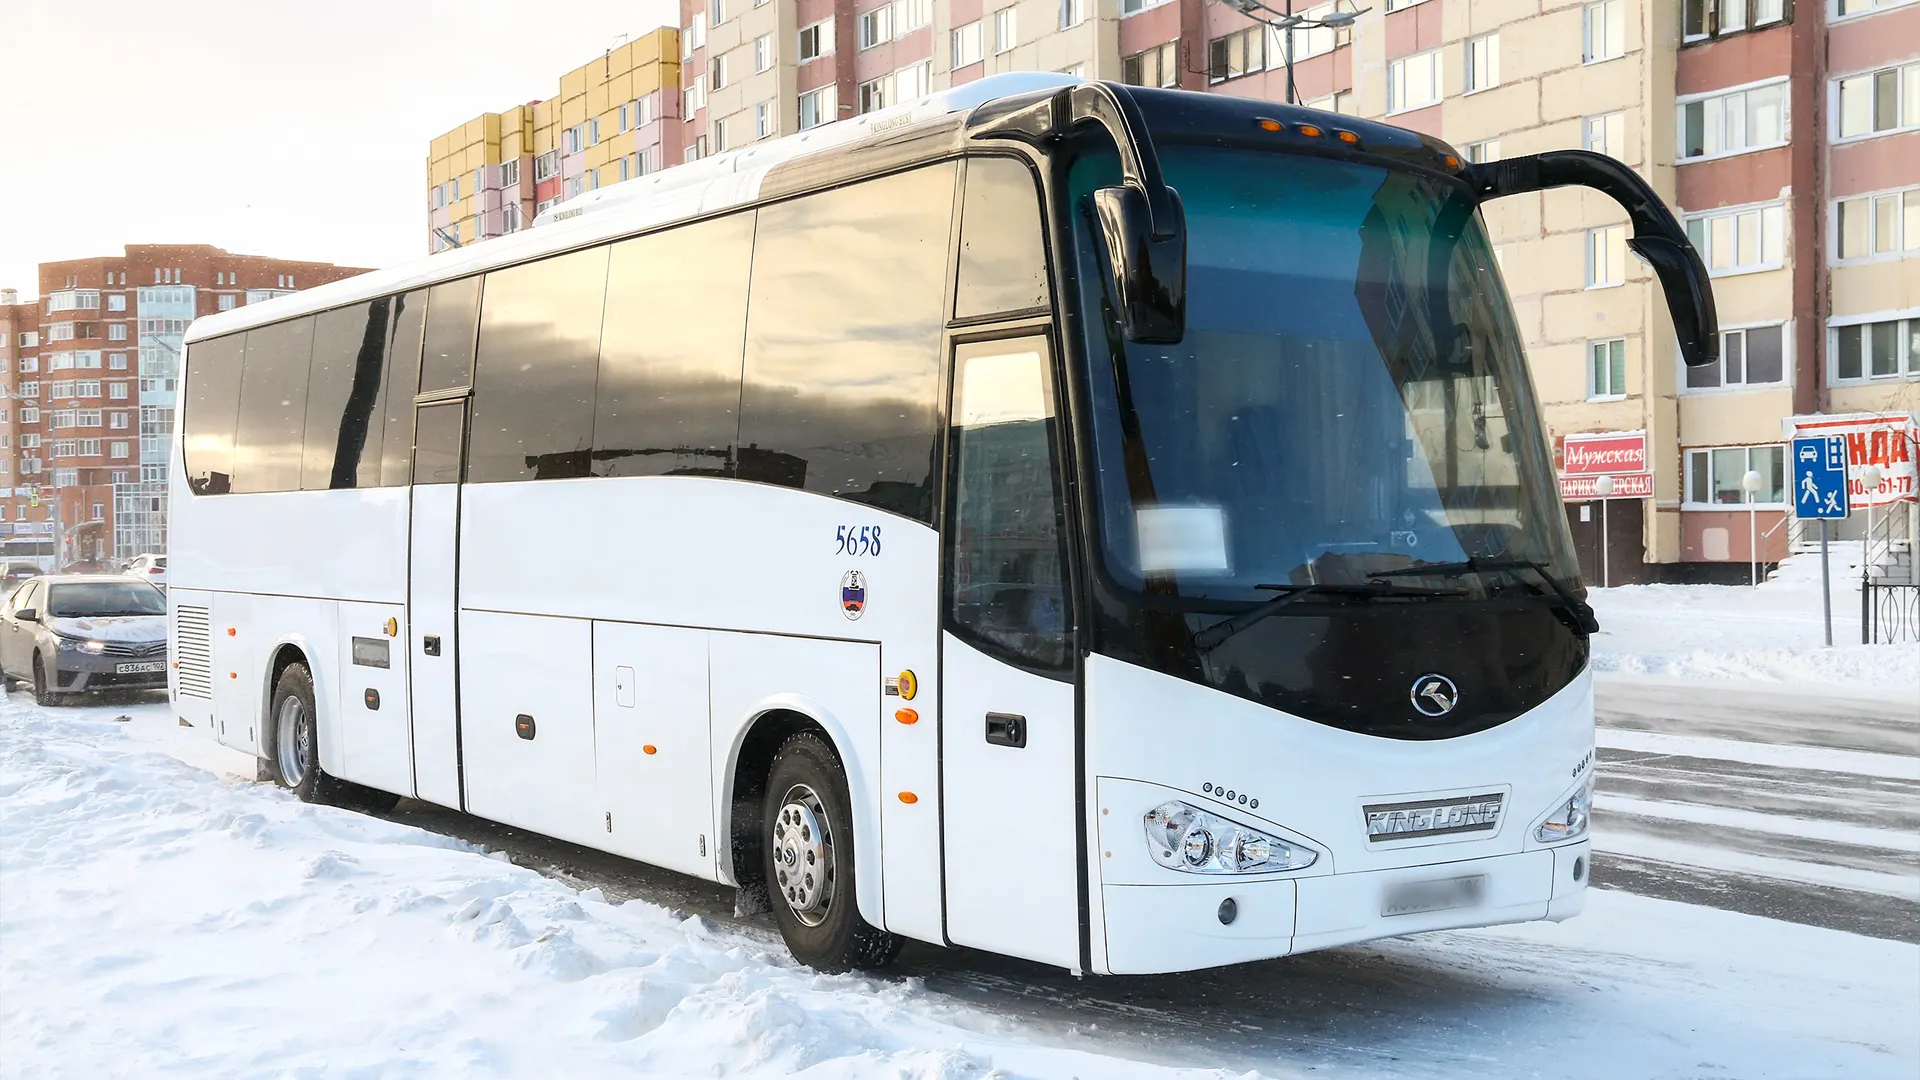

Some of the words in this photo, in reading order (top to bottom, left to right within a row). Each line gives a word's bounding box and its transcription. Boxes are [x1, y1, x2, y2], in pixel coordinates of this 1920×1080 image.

[1566, 446, 1644, 471] Мужская
[1847, 429, 1909, 469] НДА
[1560, 477, 1651, 496] ПАРИКМЕРСКАЯ
[835, 525, 881, 557] 5658
